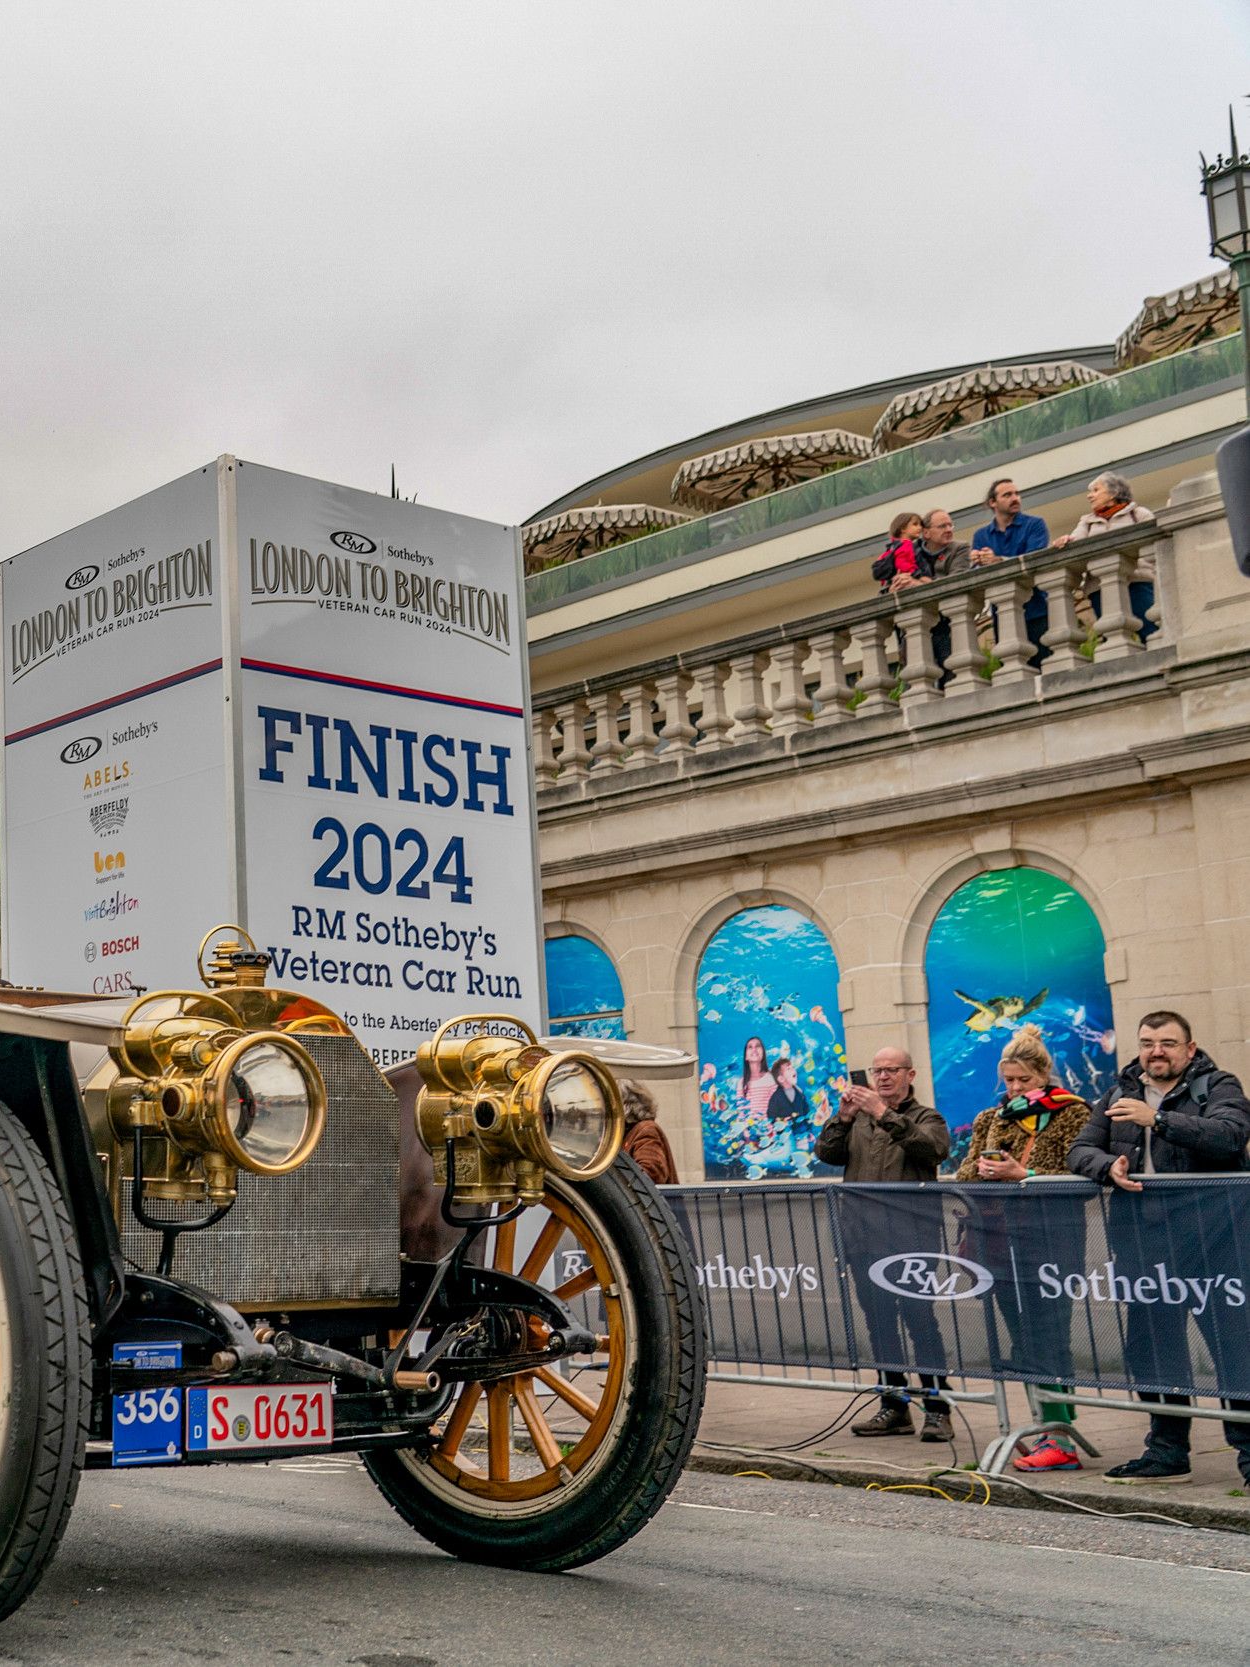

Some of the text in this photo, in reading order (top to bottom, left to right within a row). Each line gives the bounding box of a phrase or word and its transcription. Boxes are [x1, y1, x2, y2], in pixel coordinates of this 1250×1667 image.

[107, 547, 146, 571] Sotheby's
[387, 545, 434, 567] Sotheby's
[12, 539, 213, 675] LONDON TO BRIGHTON
[250, 538, 510, 646] LONDON TO BRIGHTON
[56, 608, 160, 657] VETERAN CAR RUN 2024
[317, 599, 452, 635] VETERAN CAR RUN 2024
[111, 721, 159, 746] Sotheby's
[83, 760, 130, 791] ABELS
[257, 705, 514, 816] FINISH
[89, 797, 130, 818] ABERFELDY
[93, 851, 126, 873] ben
[312, 816, 473, 904] 2024
[101, 936, 140, 957] BOSCH
[291, 905, 497, 961] RM Sotheby's
[93, 971, 132, 994] CARS
[267, 946, 522, 999] Veteran Car Run
[343, 1011, 358, 1027] to
[362, 1012, 385, 1028] the
[389, 1014, 461, 1037] Aberfely
[1037, 1260, 1246, 1315] Sotheby's
[116, 1387, 179, 1426] 356
[211, 1392, 327, 1441] S 0631
[193, 1425, 202, 1439] D
